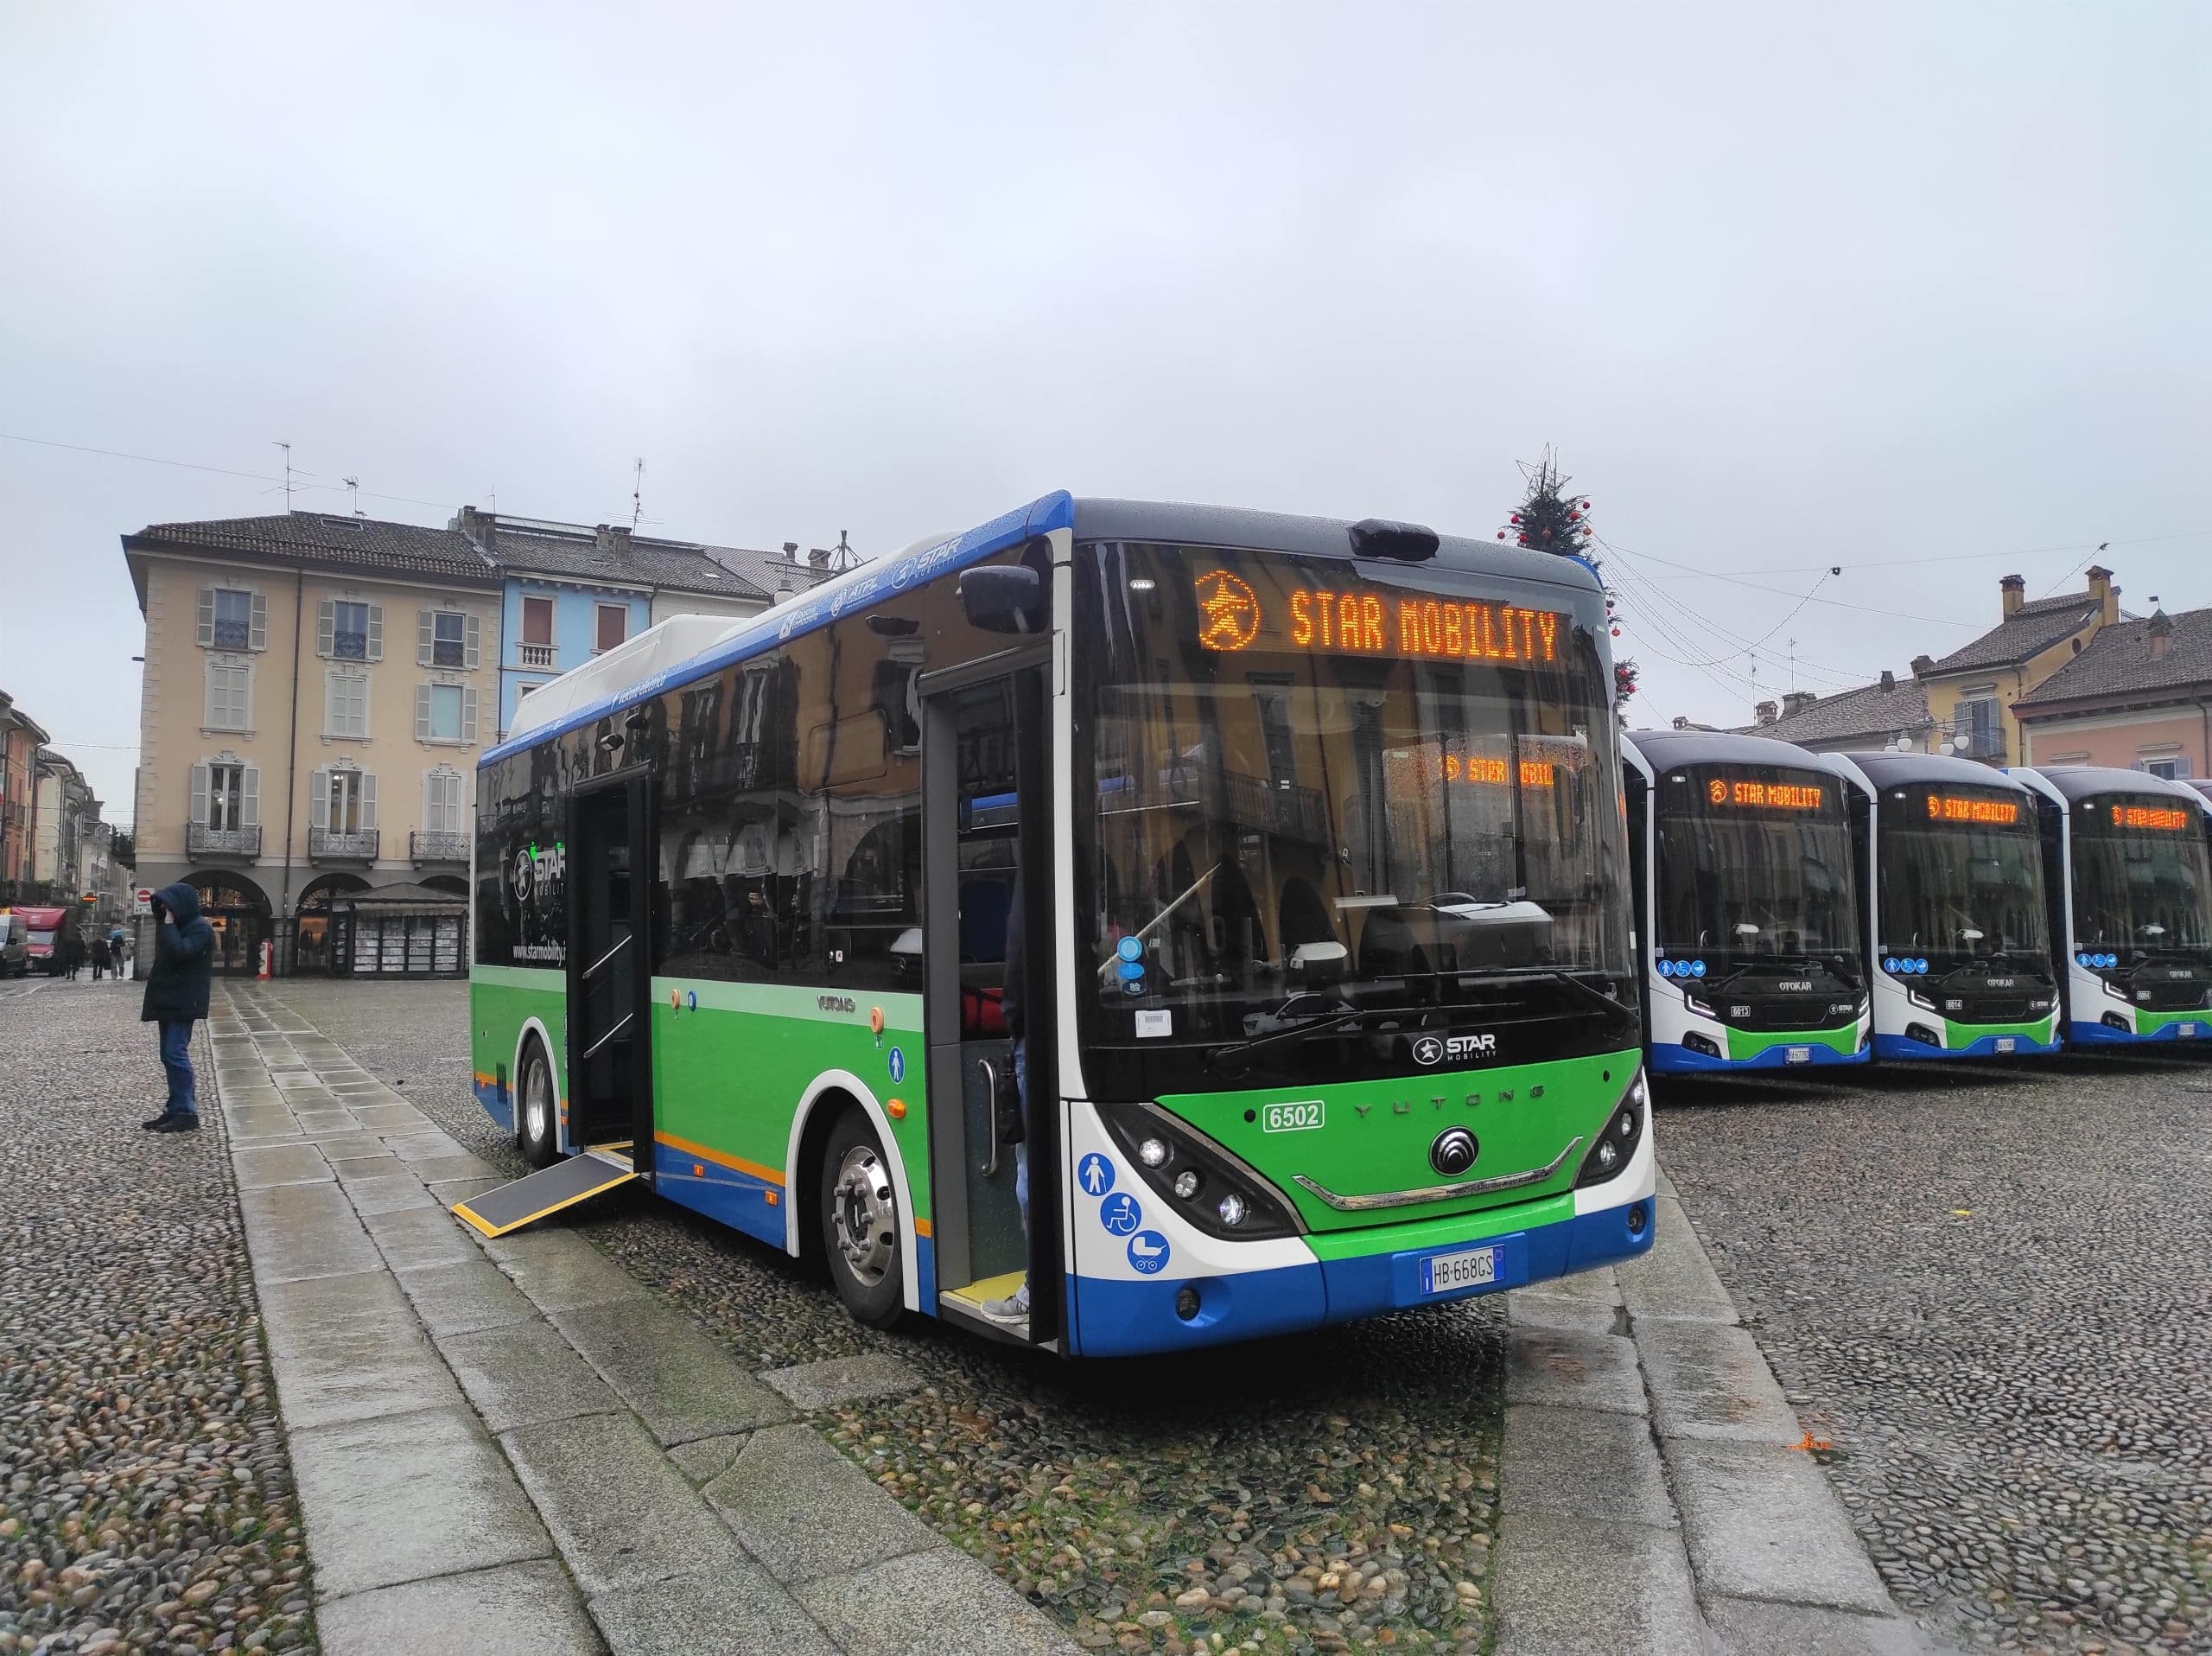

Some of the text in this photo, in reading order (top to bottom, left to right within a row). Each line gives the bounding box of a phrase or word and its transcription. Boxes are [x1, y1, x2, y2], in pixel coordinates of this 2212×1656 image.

[917, 535, 963, 570] STAR
[1292, 591, 1555, 661] STAR MOBILITY
[1469, 758, 1505, 783] STAR
[1735, 782, 1821, 809] STAR MOBILITY
[1945, 799, 2017, 823] STAR MOBILITY
[533, 846, 566, 882] STAR
[533, 882, 564, 897] MOBILIT
[512, 939, 567, 967] www.starmobility.i
[1779, 981, 1812, 991] OTOKAR
[1987, 978, 2015, 987] OTOKAR
[1732, 1007, 1749, 1016] 6013
[1446, 1034, 1496, 1054] STAR
[1447, 1050, 1497, 1061] MOBILITY
[1354, 1085, 1545, 1118] YUTONG
[1269, 1105, 1319, 1129] 6502
